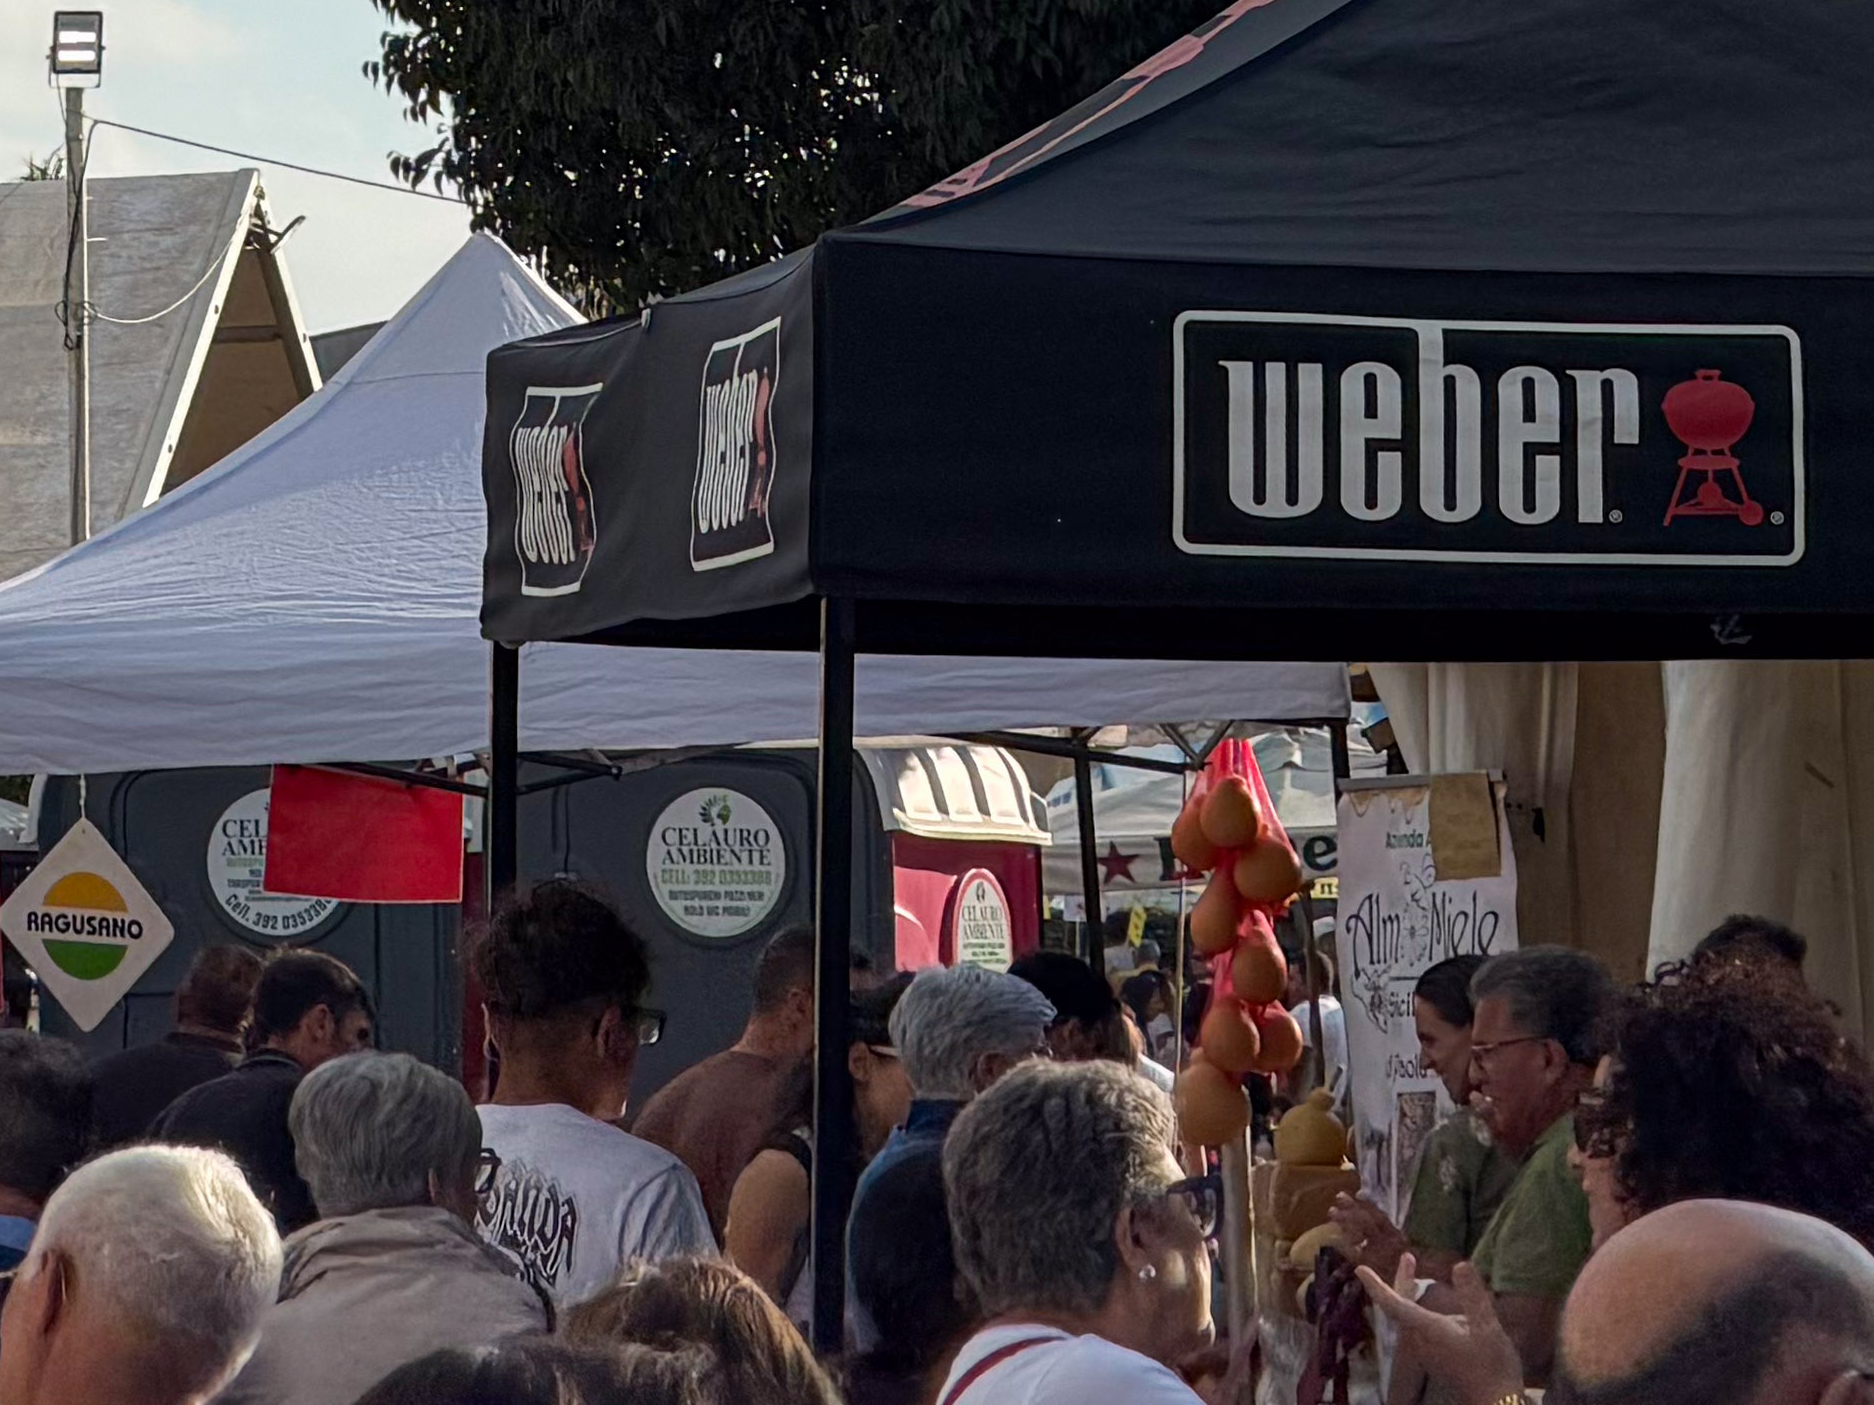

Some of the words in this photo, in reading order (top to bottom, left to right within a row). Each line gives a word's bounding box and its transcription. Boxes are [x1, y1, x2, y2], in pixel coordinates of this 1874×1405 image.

[1218, 327, 1639, 525] weber
[661, 827, 770, 848] CELAURO
[661, 848, 772, 866] AMBIENTE
[26, 910, 144, 941] RAGUSANO
